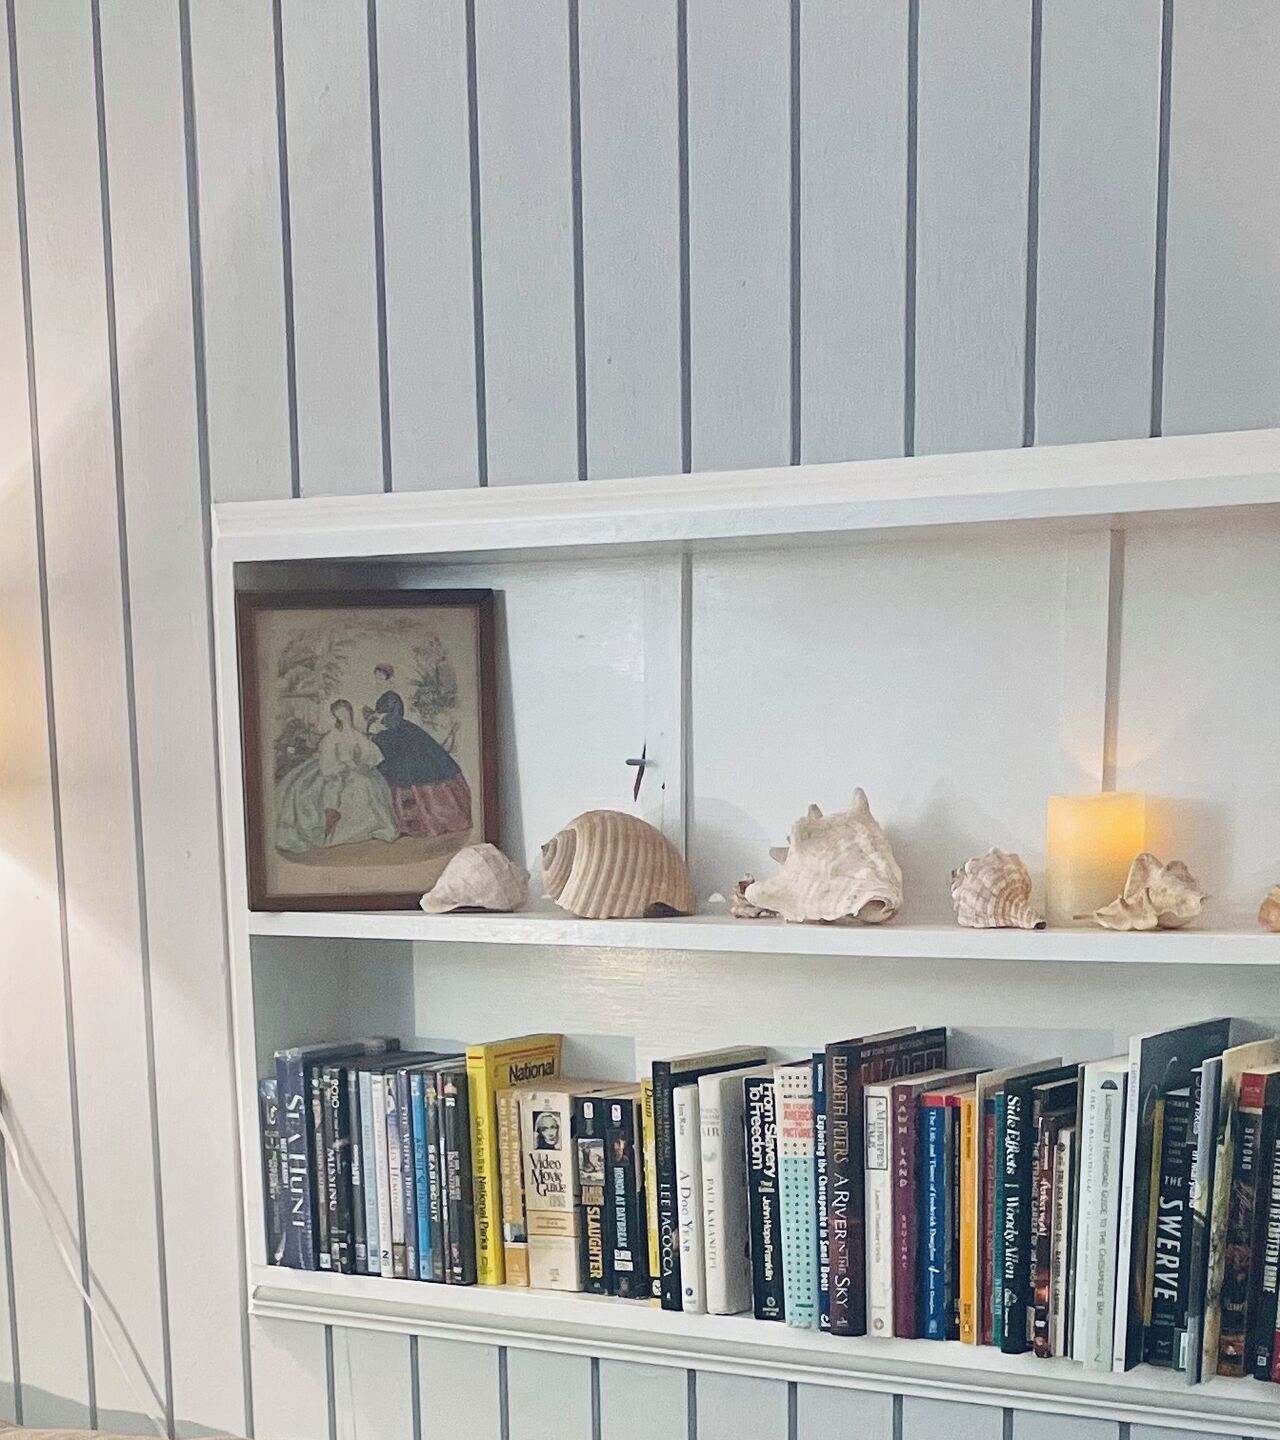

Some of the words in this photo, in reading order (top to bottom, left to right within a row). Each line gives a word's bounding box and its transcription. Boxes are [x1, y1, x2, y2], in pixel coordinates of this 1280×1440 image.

[509, 1058, 555, 1083] National
[832, 1056, 848, 1116] ELIZABETH
[331, 1079, 339, 1108] 2010
[644, 1087, 654, 1118] Dunn
[749, 1084, 763, 1101] To
[763, 1083, 776, 1122] From
[285, 1093, 305, 1144] SEA
[897, 1094, 908, 1135] DAWN
[1006, 1095, 1021, 1128] Side
[474, 1116, 486, 1145] Guide
[750, 1103, 765, 1170] Freedom
[816, 1114, 827, 1156] Exploring
[833, 1119, 848, 1163] PETERS
[476, 1147, 486, 1157] to
[529, 1153, 561, 1170] Video
[764, 1123, 778, 1178] Slavery
[1004, 1129, 1020, 1175] Effects
[1032, 1141, 1040, 1158] THE
[1242, 1127, 1255, 1170] BEYOND
[327, 1148, 337, 1211] MISSING
[477, 1159, 487, 1174] the
[531, 1169, 563, 1185] Movie
[613, 1167, 625, 1195] HONOR
[680, 1170, 690, 1181] A
[818, 1159, 827, 1173] the
[833, 1173, 849, 1187] A
[899, 1147, 908, 1188] LAND
[1031, 1161, 1040, 1198] STRANGE
[289, 1153, 306, 1227] HUNT
[428, 1144, 437, 1222] SEABISCUIT
[477, 1175, 488, 1218] National
[536, 1182, 566, 1197] Guide
[660, 1183, 672, 1207] LEE
[930, 1184, 937, 1192] of
[1164, 1176, 1183, 1188] THE
[504, 1179, 513, 1222] WOODS
[615, 1196, 625, 1206] AT
[762, 1196, 771, 1219] John
[818, 1175, 829, 1228] Chesapeake
[832, 1190, 850, 1239] RIVER
[1099, 1191, 1108, 1214] GUIDE
[615, 1207, 628, 1247] DAYBREAK
[762, 1220, 772, 1244] Hope
[1004, 1197, 1019, 1243] Woody
[1031, 1200, 1039, 1236] CAREER
[1099, 1218, 1106, 1228] TO
[479, 1221, 490, 1251] Parks
[587, 1206, 603, 1278] SLAUGHTER
[662, 1212, 673, 1276] IACOCCA
[820, 1230, 828, 1238] in
[928, 1229, 937, 1260] Douglass
[1031, 1236, 1038, 1246] OF
[1098, 1231, 1106, 1245] THE
[1153, 1195, 1186, 1303] SWERVE
[1265, 1221, 1279, 1264] EASTERN
[764, 1245, 774, 1280] Franklin
[819, 1240, 829, 1264] Small
[1005, 1242, 1019, 1279] Allen
[820, 1266, 830, 1291] Boats
[1097, 1248, 1106, 1298] CHESAPEAKE
[1262, 1265, 1277, 1293] SHORE
[835, 1275, 851, 1308] SKY
[1096, 1301, 1104, 1316] BAY
